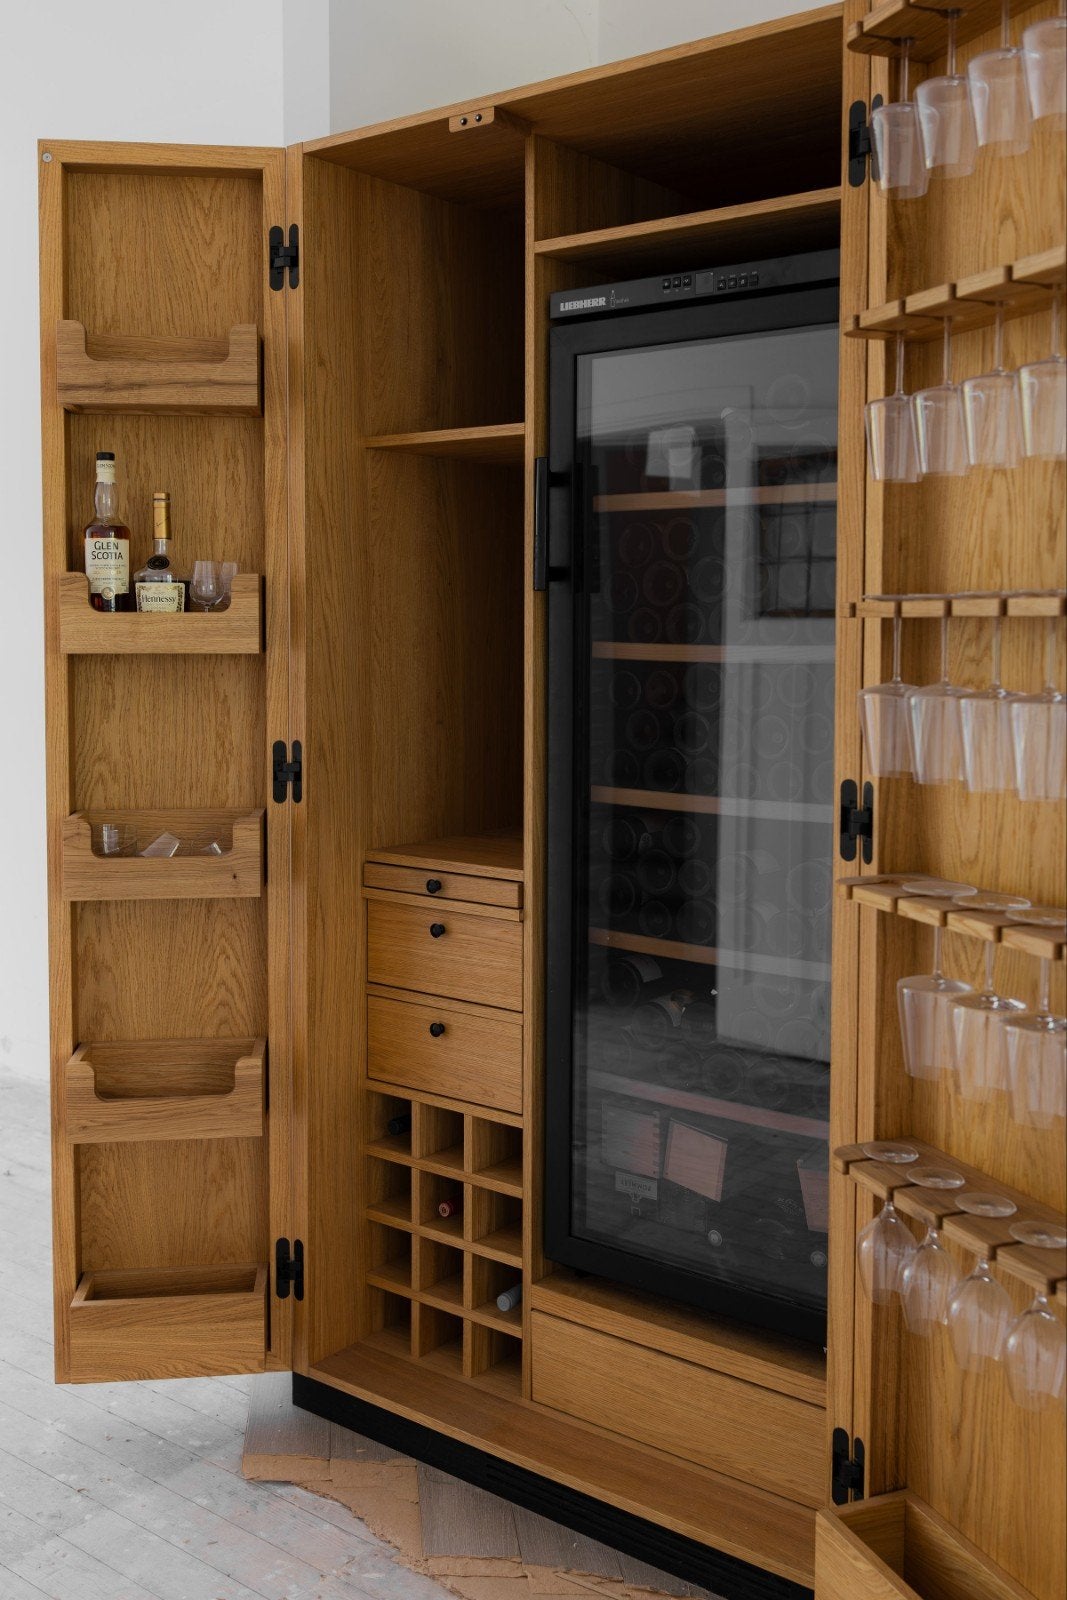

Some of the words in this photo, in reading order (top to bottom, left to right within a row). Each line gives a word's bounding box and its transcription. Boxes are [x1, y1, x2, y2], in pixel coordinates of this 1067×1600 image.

[560, 297, 606, 311] LIEBHERR
[94, 541, 119, 550] GLEN
[91, 551, 123, 560] SCOTIA
[141, 594, 176, 605] Hennessy
